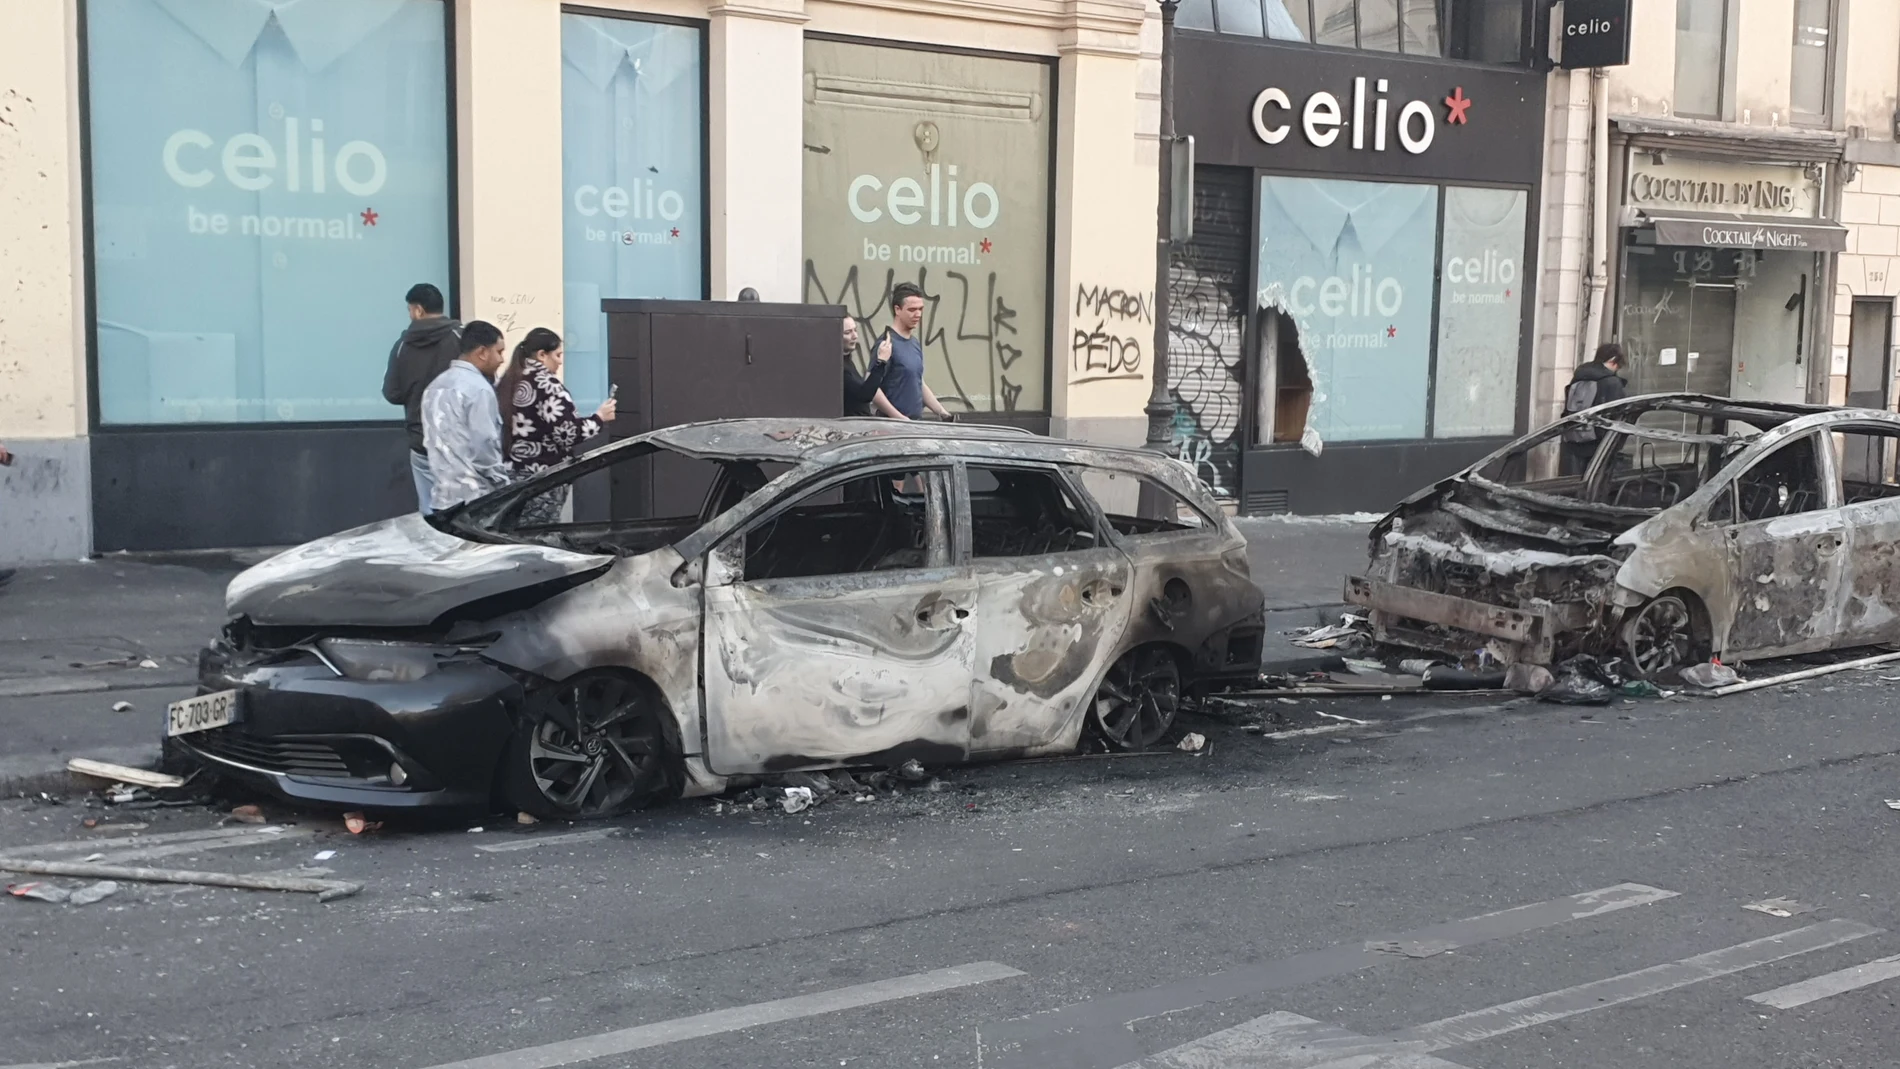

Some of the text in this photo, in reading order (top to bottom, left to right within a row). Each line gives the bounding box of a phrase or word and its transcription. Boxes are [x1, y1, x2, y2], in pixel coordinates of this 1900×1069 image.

[1567, 18, 1610, 36] celio
[1252, 77, 1435, 154] celio
[162, 117, 387, 196] celio
[574, 178, 684, 221] celio
[847, 163, 999, 229] celio
[188, 205, 229, 234] be
[585, 226, 606, 241] be
[863, 237, 891, 261] be
[1448, 249, 1515, 284] celio
[1076, 282, 1153, 326] MACRON
[1291, 264, 1403, 317] celio
[1072, 319, 1141, 373] PÉDO
